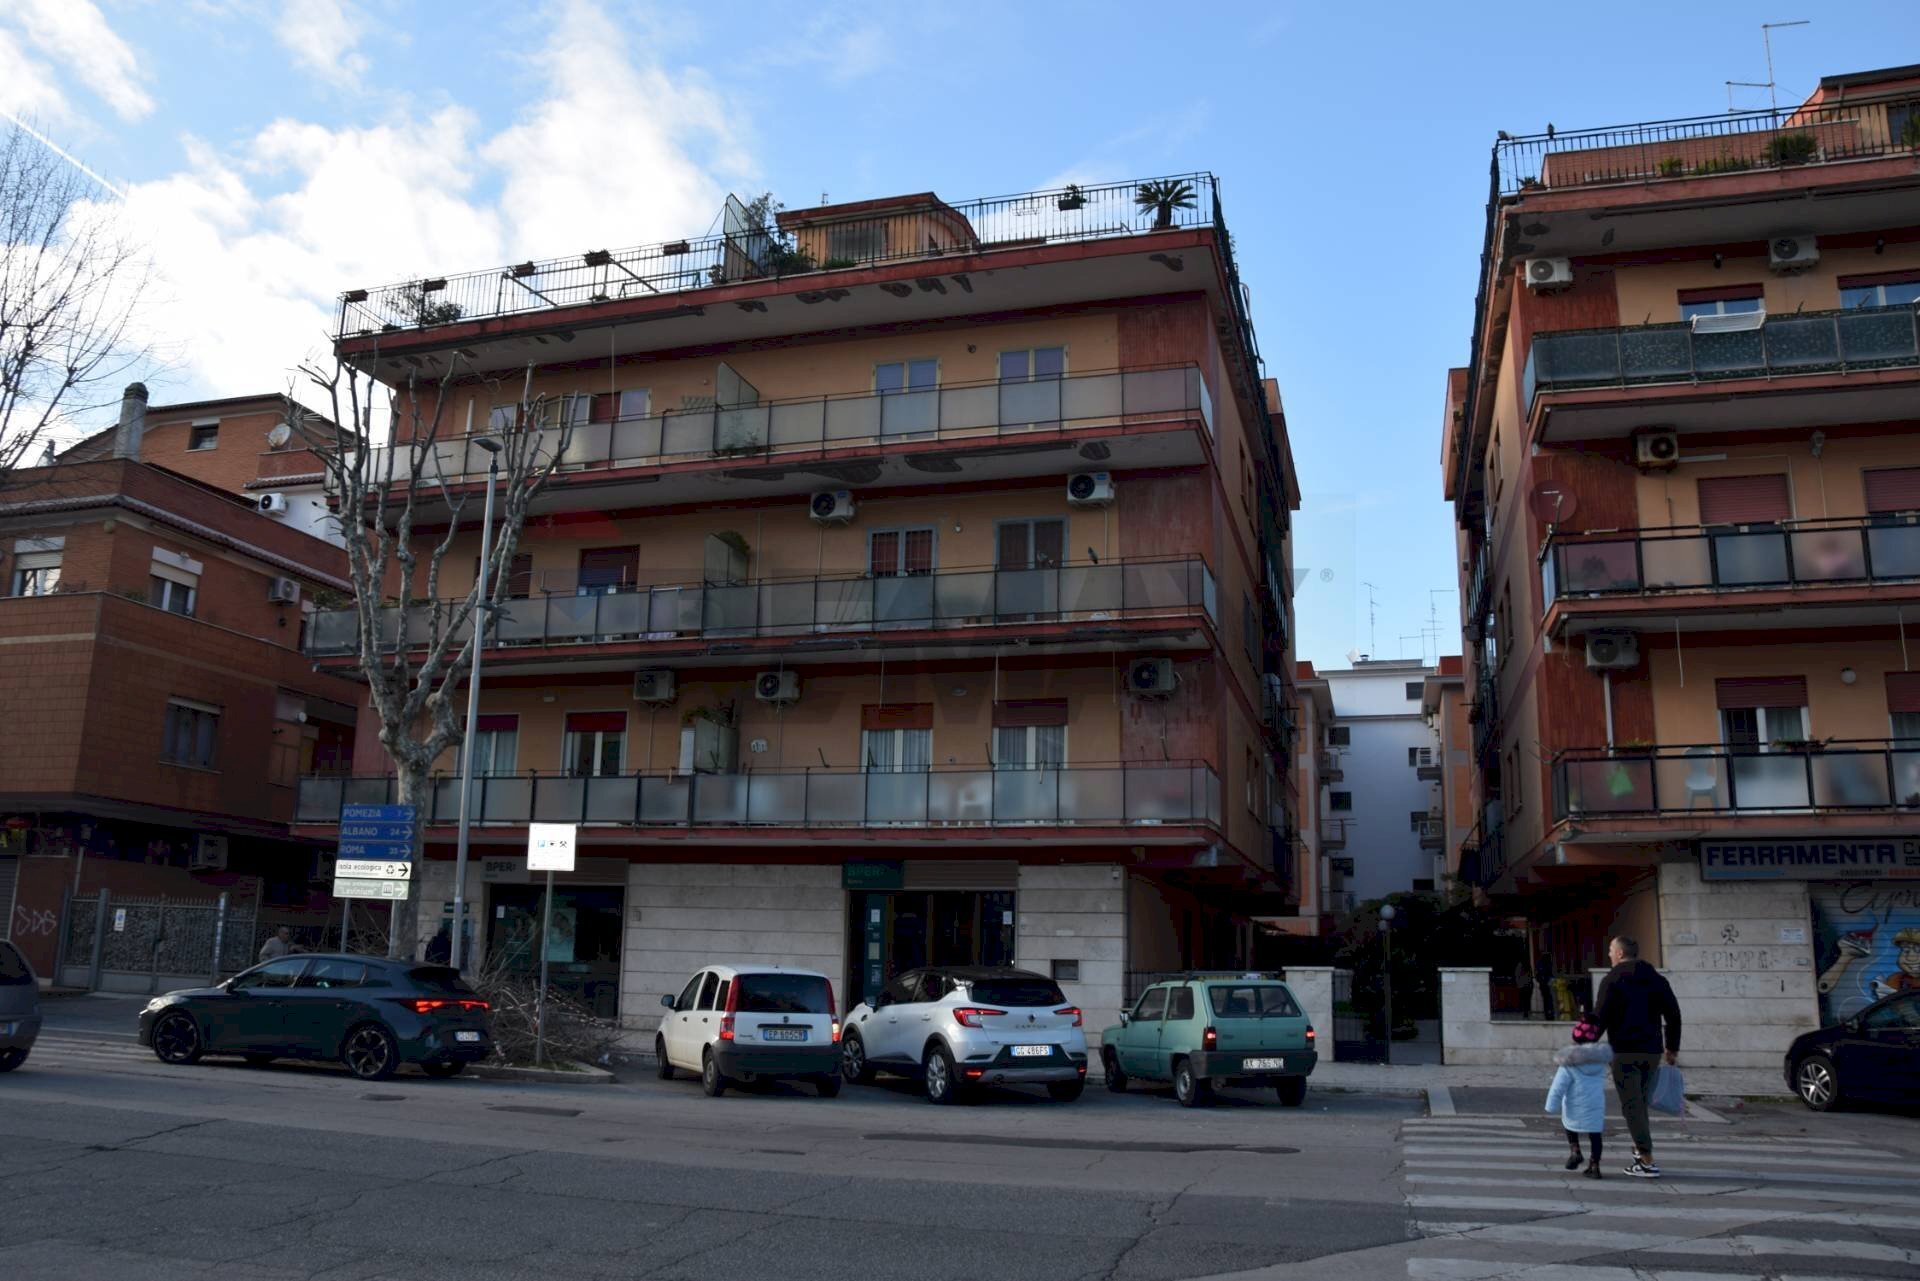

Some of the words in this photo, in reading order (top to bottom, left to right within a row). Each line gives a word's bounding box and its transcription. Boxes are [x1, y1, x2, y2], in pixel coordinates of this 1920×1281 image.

[343, 808, 382, 818] POMEZIA
[342, 826, 378, 837] ALBANO
[340, 845, 365, 854] ROMA
[1706, 844, 1896, 866] FERRAMENTA
